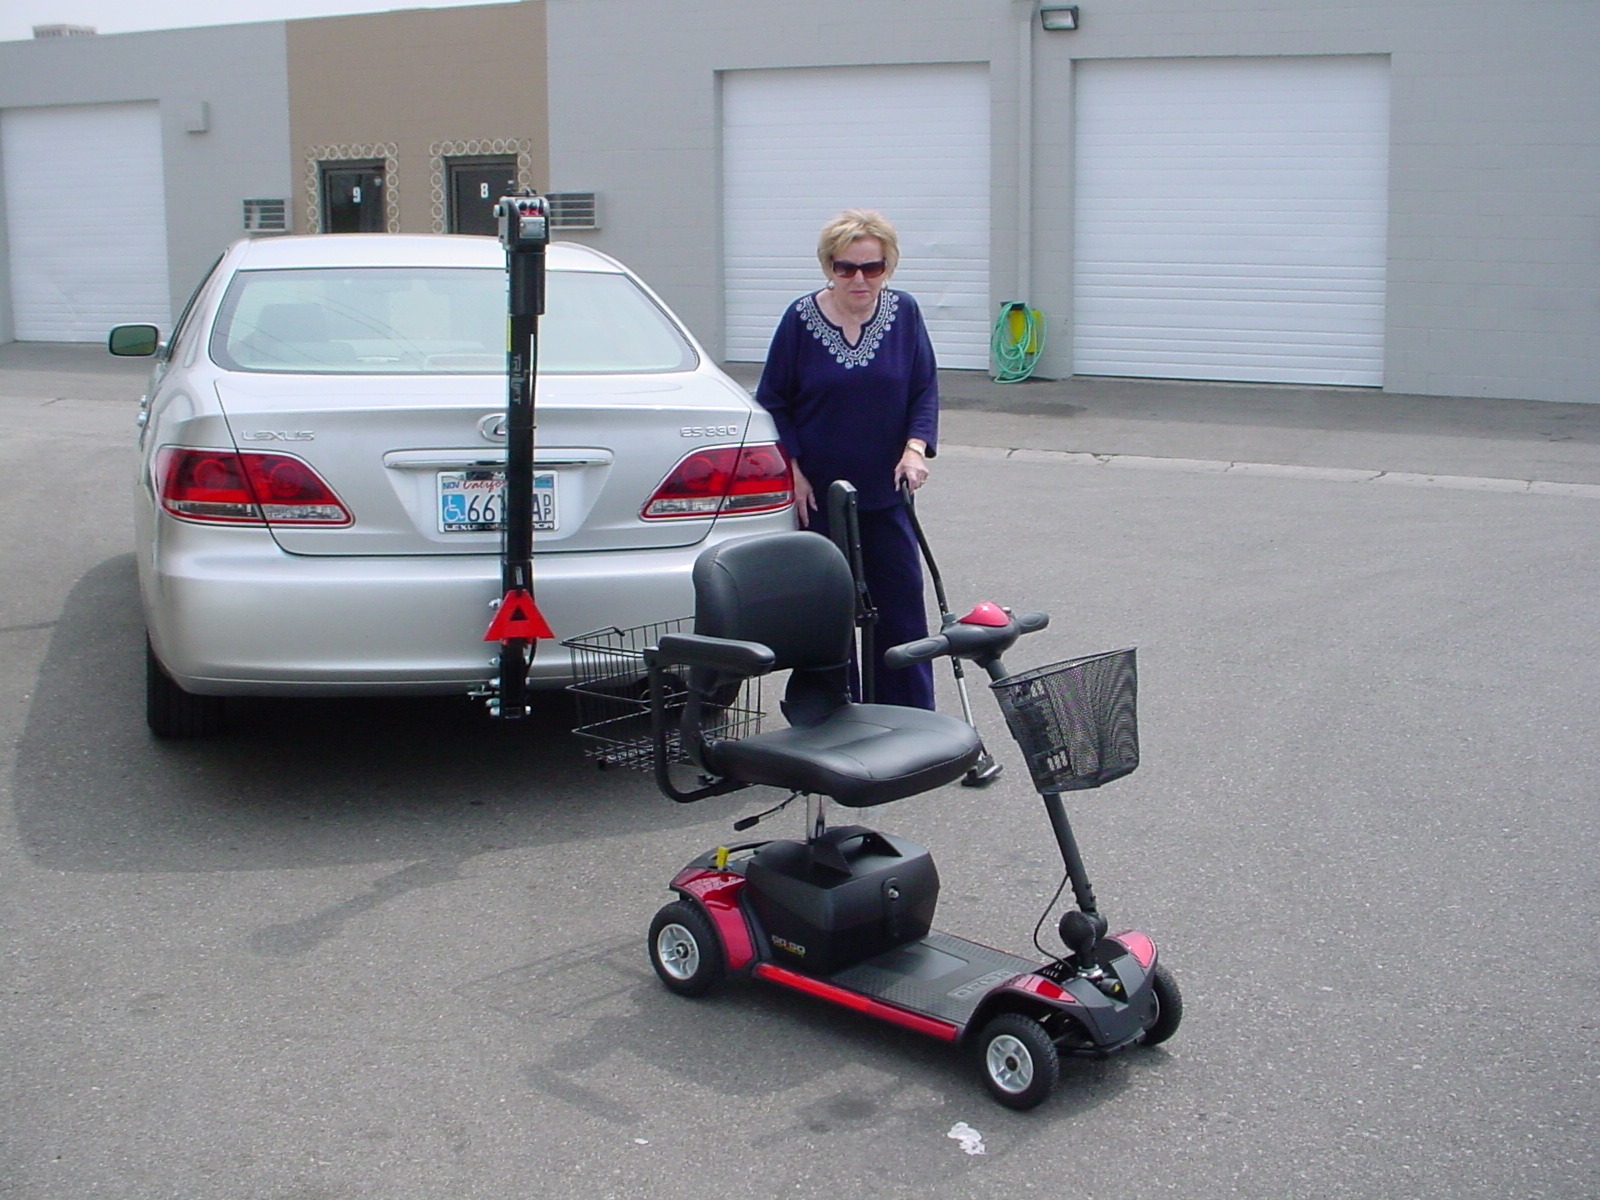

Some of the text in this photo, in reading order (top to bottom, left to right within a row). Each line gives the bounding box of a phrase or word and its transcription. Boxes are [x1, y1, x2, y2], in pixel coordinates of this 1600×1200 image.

[352, 186, 361, 203] 9
[480, 182, 488, 198] 8
[242, 430, 315, 441] LEXUS
[680, 425, 738, 437] ES 330
